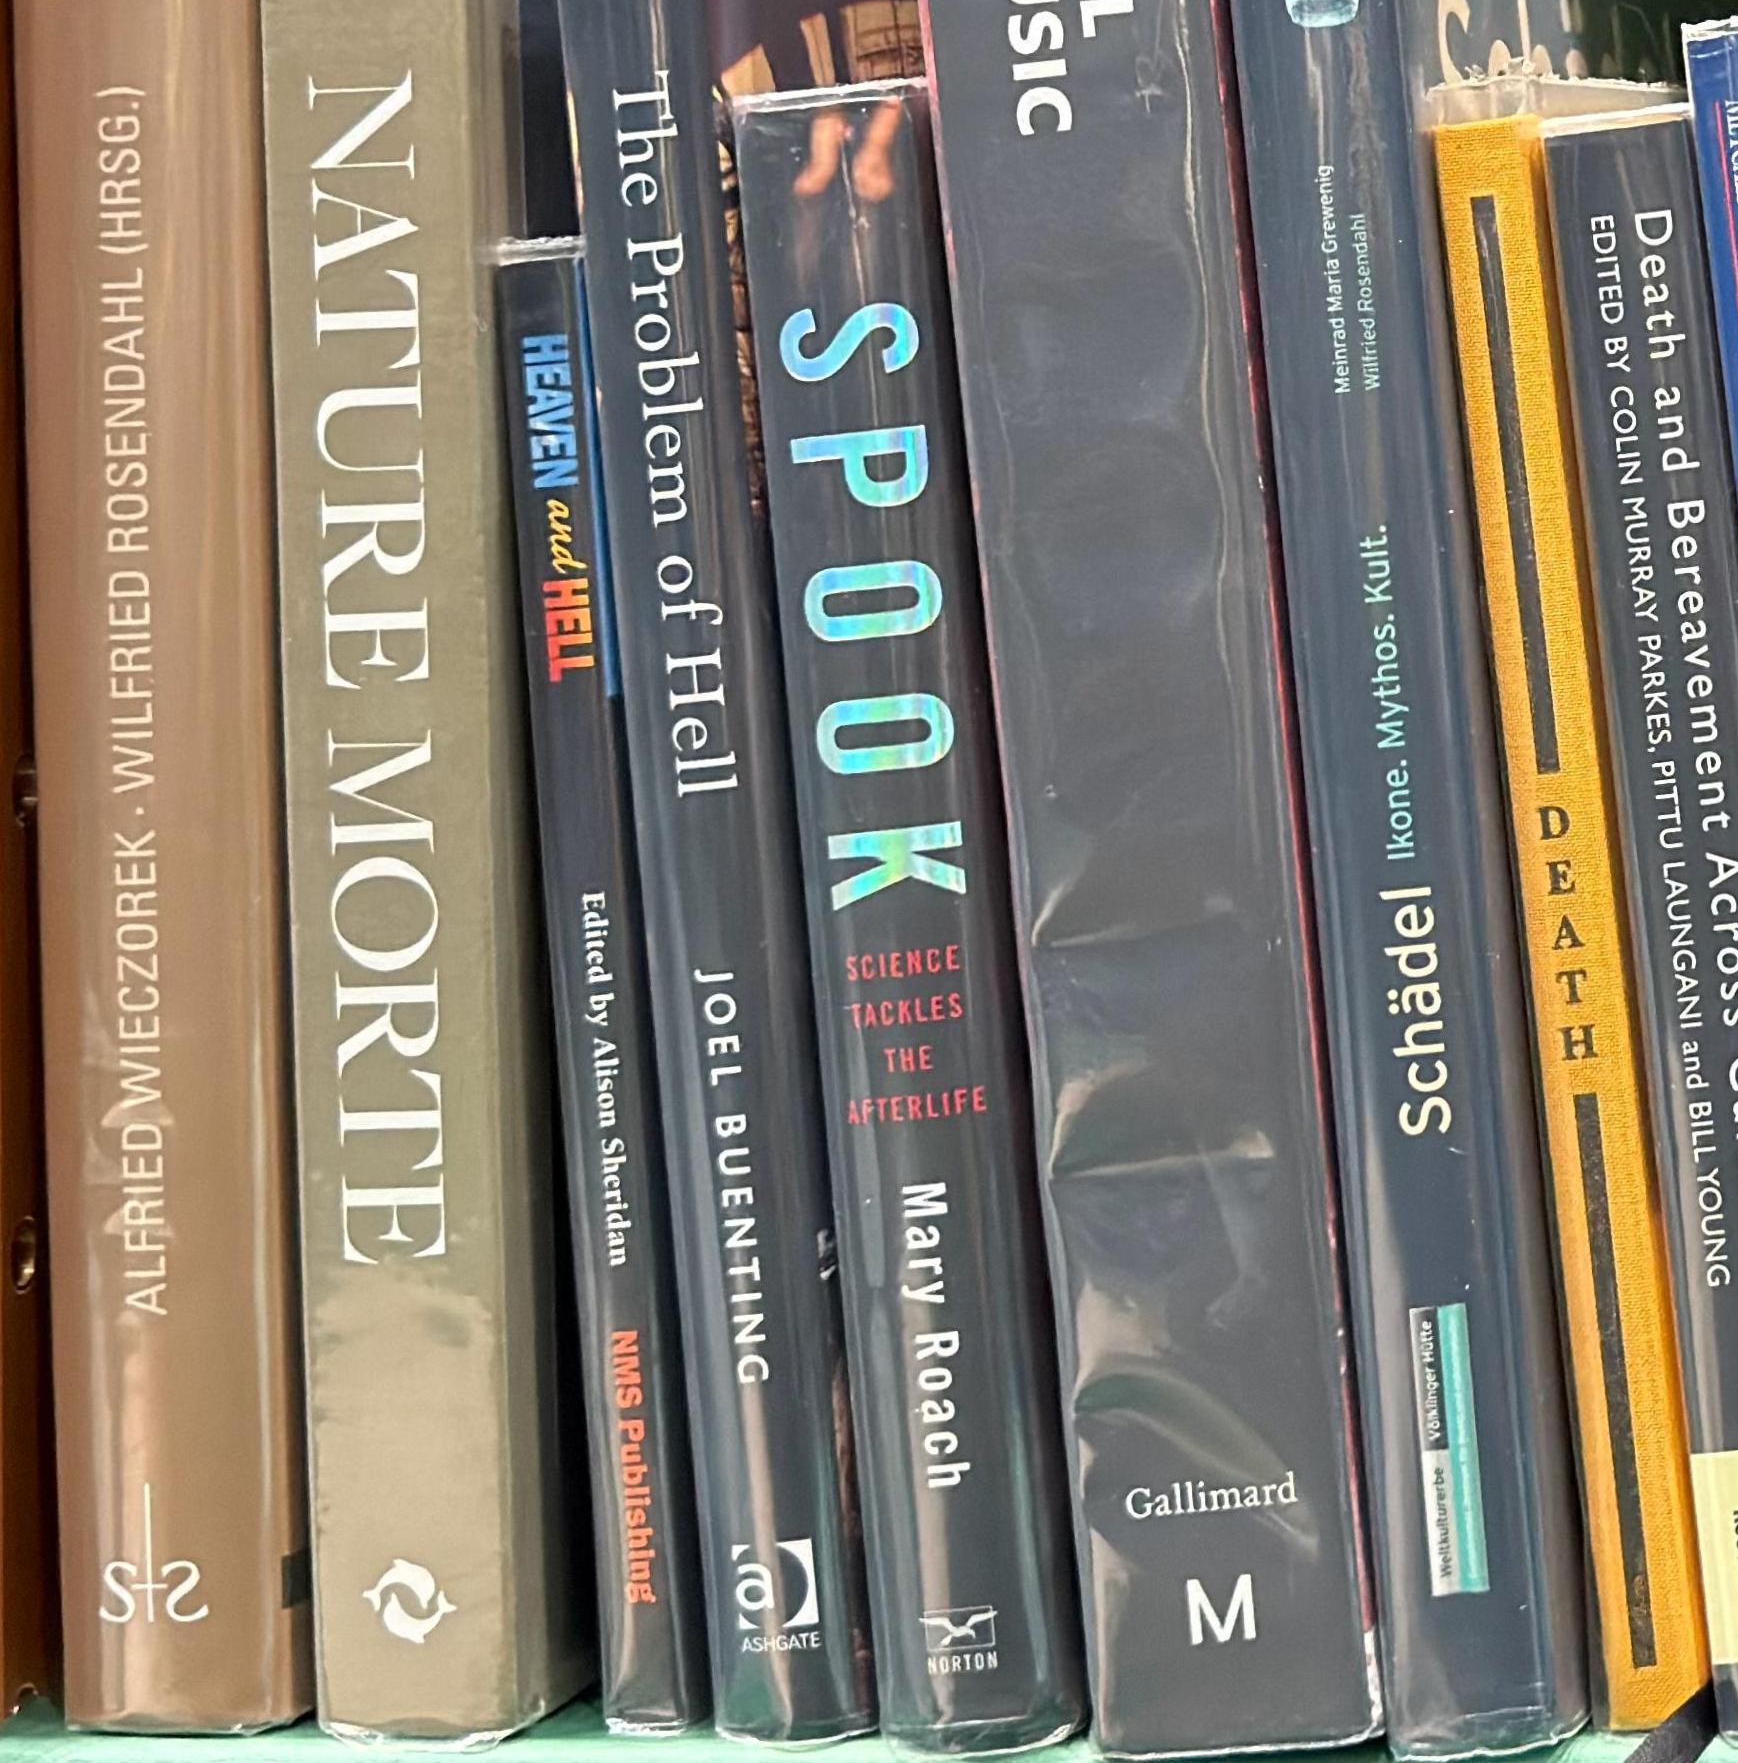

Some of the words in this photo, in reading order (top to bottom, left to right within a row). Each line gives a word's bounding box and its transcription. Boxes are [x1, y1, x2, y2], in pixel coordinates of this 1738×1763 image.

[95, 86, 147, 254] (HRSG.)
[613, 67, 680, 206] The
[1314, 165, 1338, 253] Grewenig
[1351, 212, 1375, 313] Rosendahl
[1324, 257, 1344, 313] Maria
[1591, 215, 1625, 326] EDITED
[1635, 209, 1686, 359] Death
[308, 69, 431, 689] NATURE
[628, 234, 703, 529] Problem
[1329, 317, 1351, 394] Meinrad
[1359, 318, 1381, 391] Wilfried
[1604, 336, 1629, 376] BY
[101, 268, 150, 552] ROSENDAHL
[521, 333, 579, 490] HEAVEN
[1610, 387, 1643, 485] COLIN
[1655, 385, 1700, 472] and
[546, 498, 588, 575] and
[658, 554, 724, 627] of
[1360, 523, 1392, 604] Kult.
[1622, 497, 1659, 619] MURRAY
[543, 577, 595, 683] HELL
[780, 300, 968, 912] SPOOK
[109, 570, 154, 793] WILFRIED
[1372, 613, 1408, 749] Mythos.
[1638, 636, 1673, 754] PARKES,
[1668, 497, 1730, 832] Bereavement
[666, 646, 738, 800] Hell
[1386, 758, 1415, 860] Ikone.
[1651, 760, 1684, 850] PITTU
[113, 829, 161, 1111] WIECZOREK
[581, 891, 613, 984] Edited
[845, 945, 961, 982] SCIENCE
[1537, 805, 1599, 1062] DEATH
[1663, 861, 1703, 1029] LAUNGANI
[326, 729, 447, 1267] MORTE
[585, 992, 615, 1027] by
[695, 969, 742, 1088] JOEL
[851, 992, 963, 1030] TACKLES
[1379, 886, 1452, 1135] Schädel
[593, 1037, 619, 1128] Alison
[848, 1085, 987, 1125] AFTERLIFE
[884, 1044, 934, 1073] THE
[1682, 1042, 1708, 1091] and
[1690, 1101, 1717, 1162] BILL
[124, 1122, 168, 1316] ALFRIED
[601, 1137, 632, 1268] Sheridan
[716, 1114, 771, 1387] BUENTING
[900, 1181, 949, 1306] Mary
[1697, 1167, 1731, 1286] YOUNG
[611, 1329, 643, 1410] NMS
[911, 1329, 972, 1490] Roach
[617, 1418, 657, 1604] Publishing
[1125, 1470, 1298, 1519] Gallimard
[742, 1631, 822, 1653] ASHGATE
[927, 1651, 998, 1675] NORTON
[1186, 1574, 1256, 1646] M
